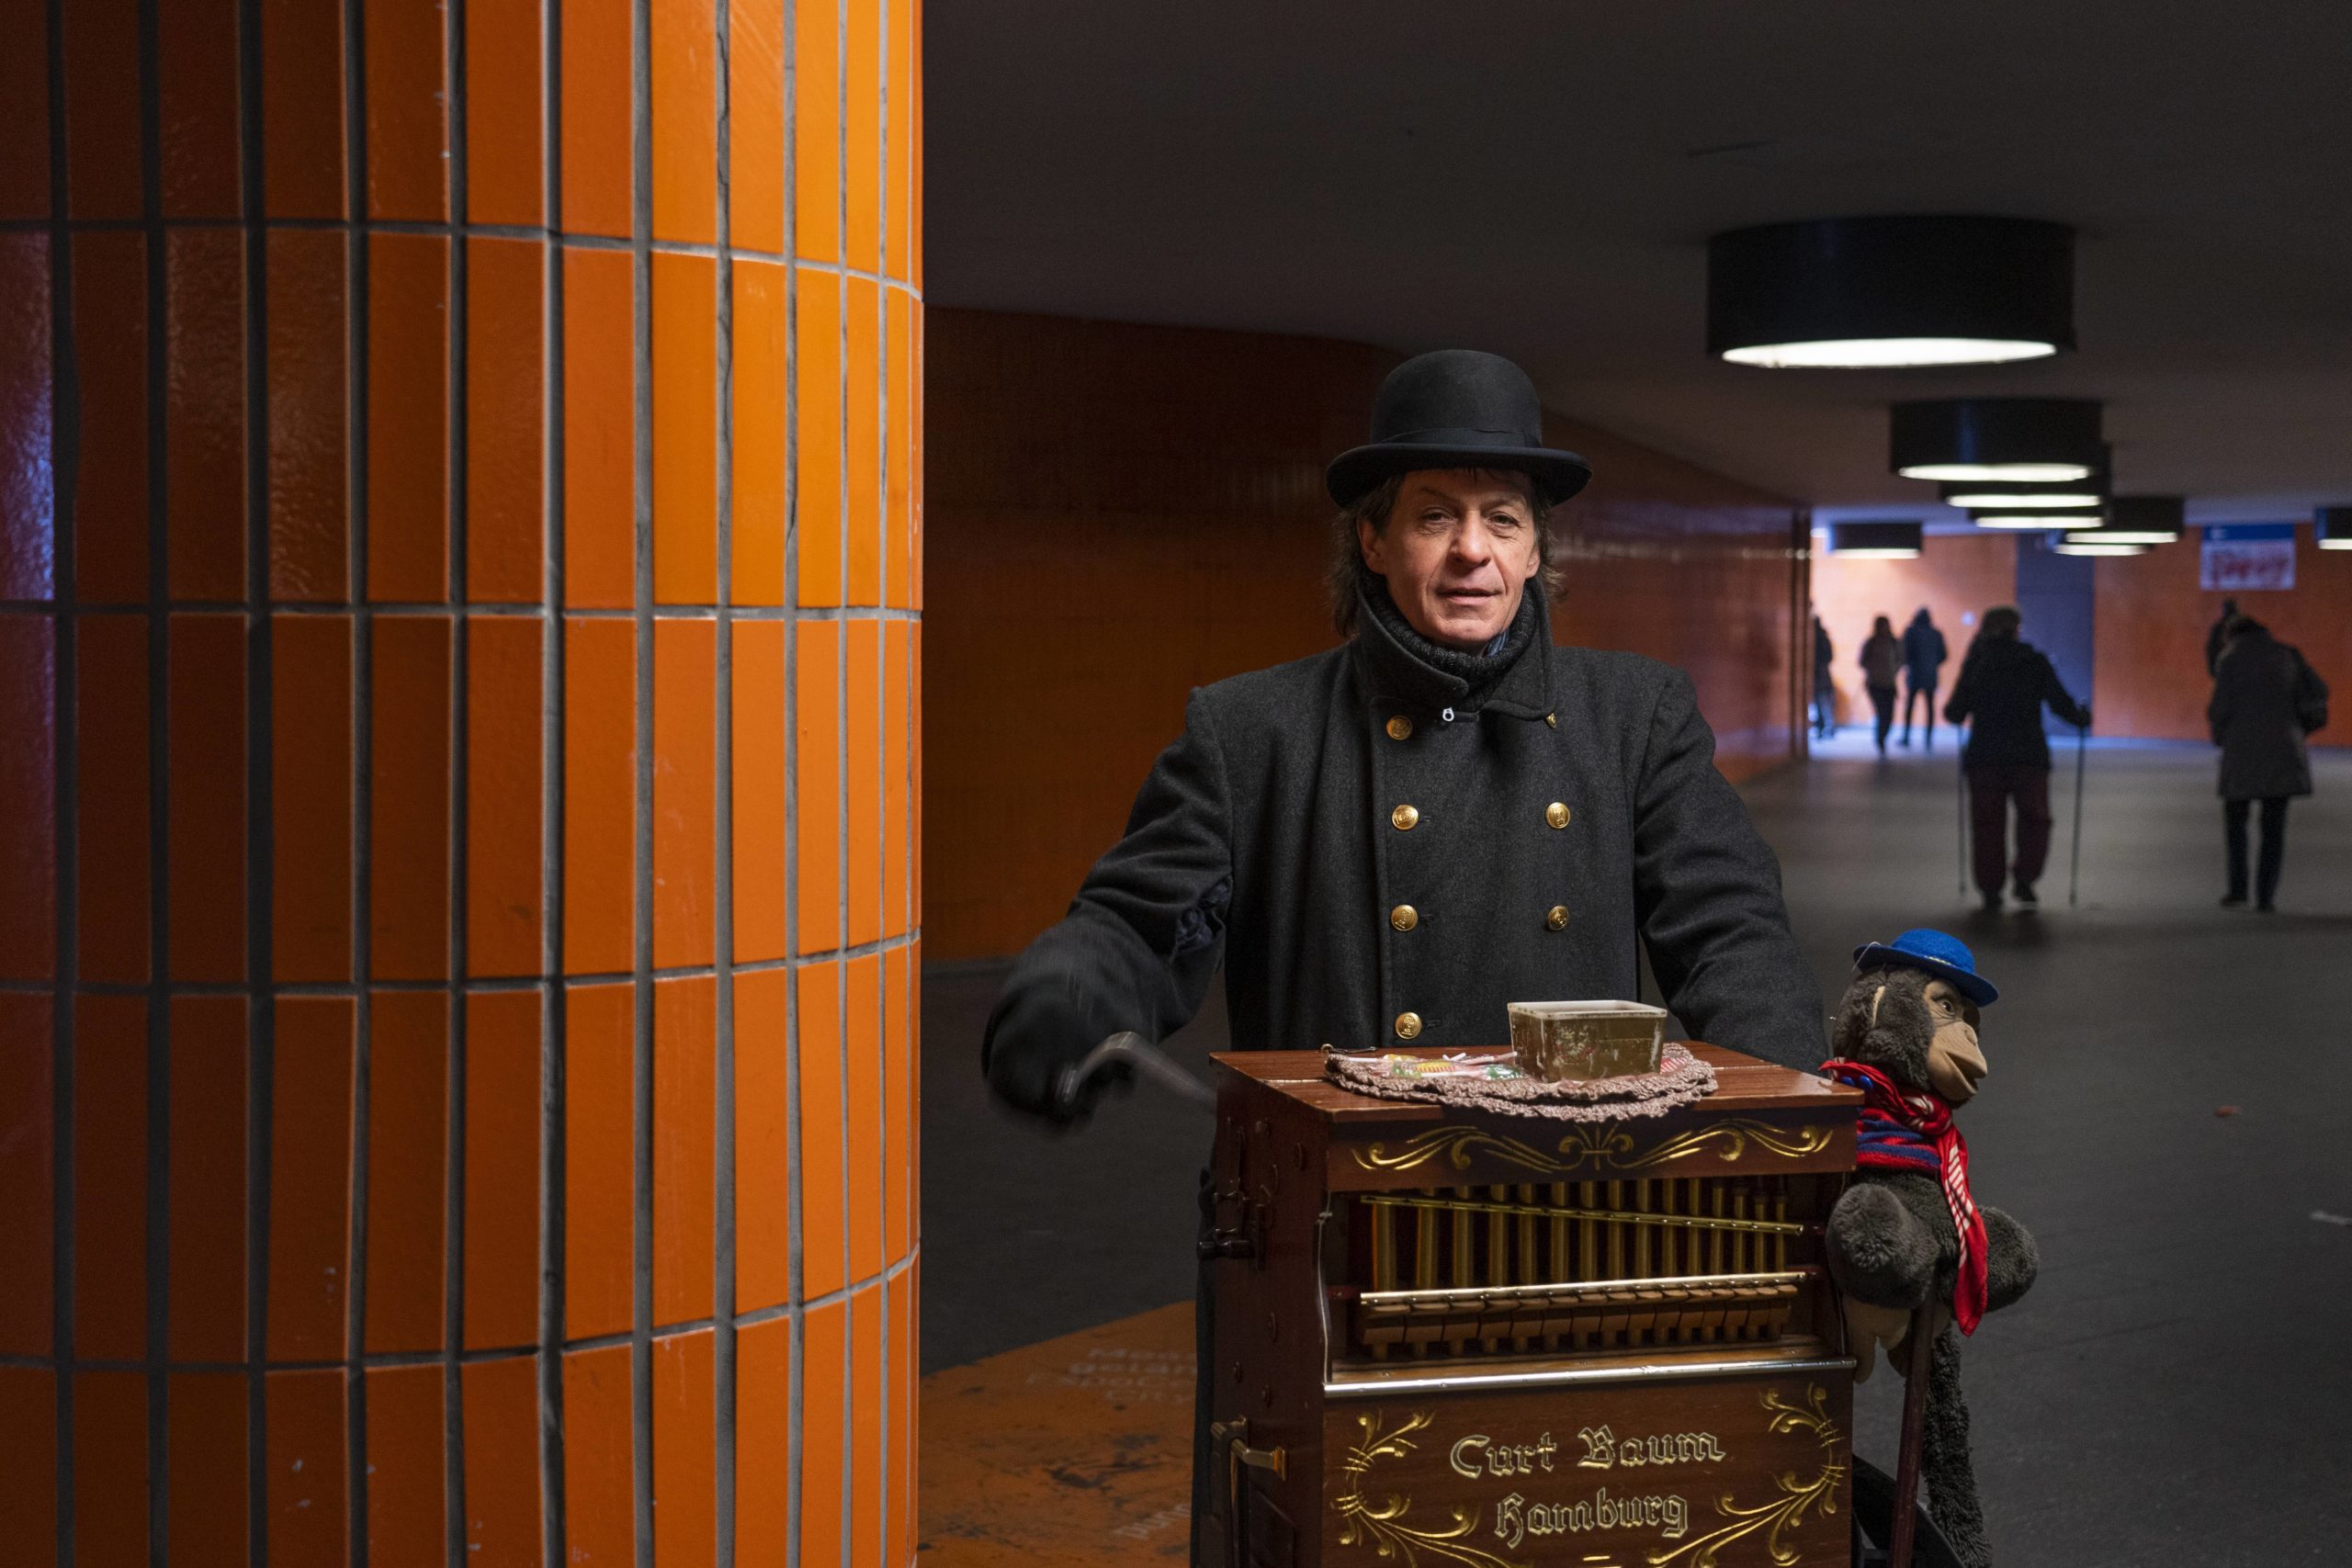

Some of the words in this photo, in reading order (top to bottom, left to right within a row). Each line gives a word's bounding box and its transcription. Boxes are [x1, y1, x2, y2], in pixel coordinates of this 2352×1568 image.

[1450, 1433, 1557, 1479] Curt
[1577, 1425, 1725, 1470] Baum
[1494, 1487, 1689, 1550] Hamburg
